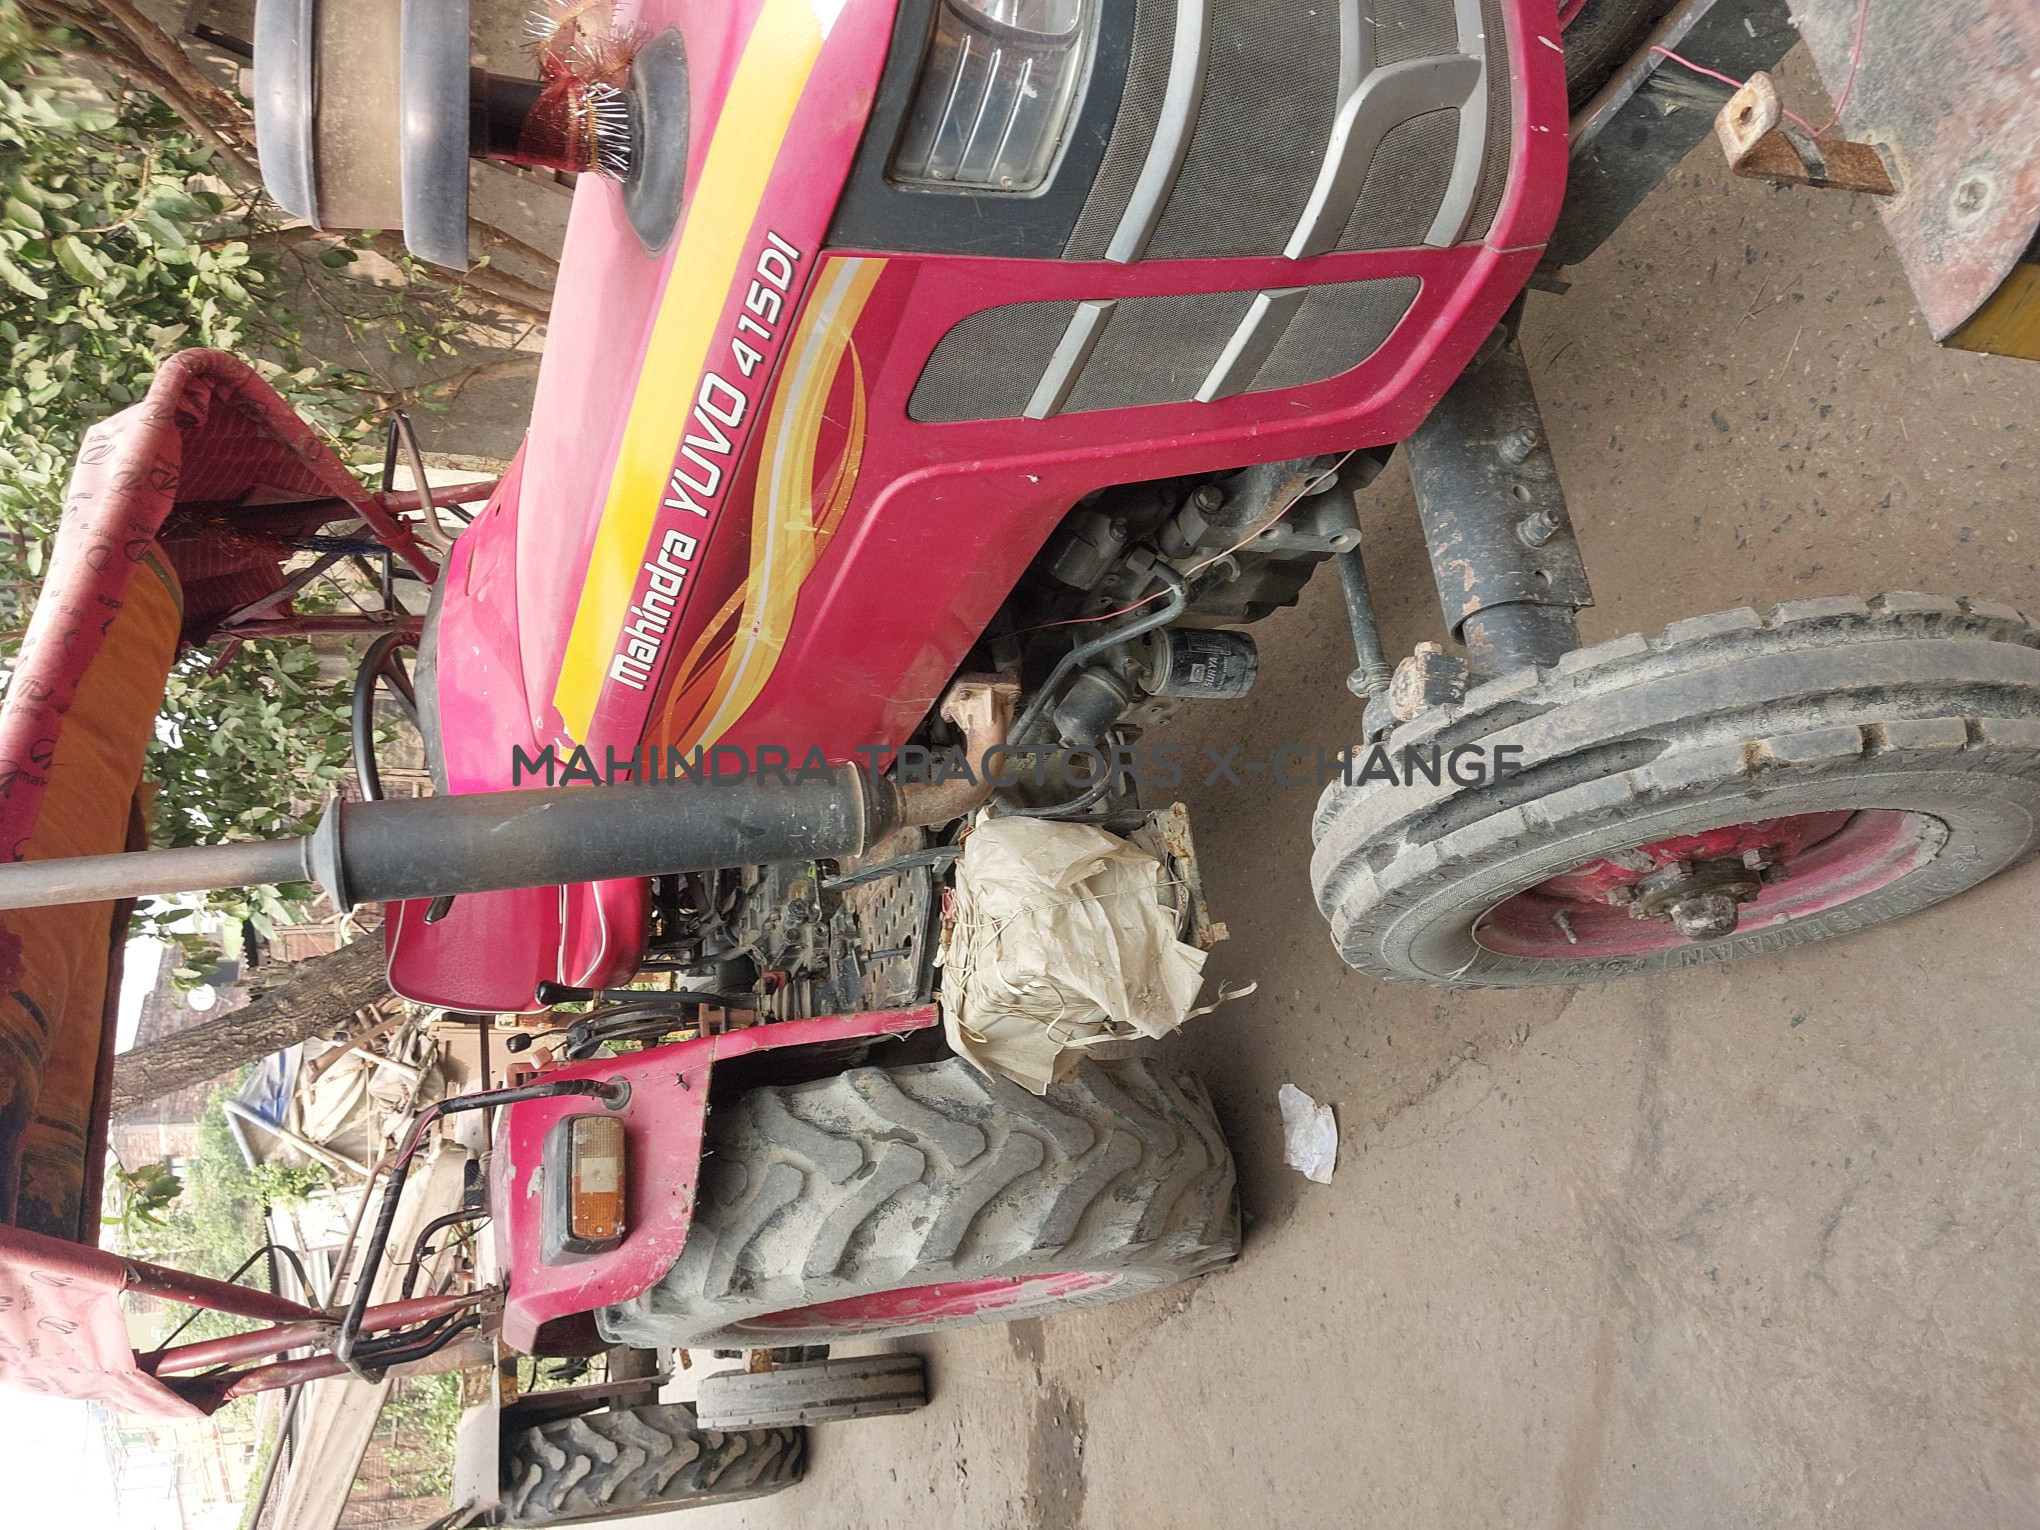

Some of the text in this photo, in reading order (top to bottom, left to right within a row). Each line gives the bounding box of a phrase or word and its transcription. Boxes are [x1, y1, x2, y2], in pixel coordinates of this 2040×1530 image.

[608, 230, 800, 691] Mahindra YUVO 415DI
[1204, 656, 1218, 686] SURYA
